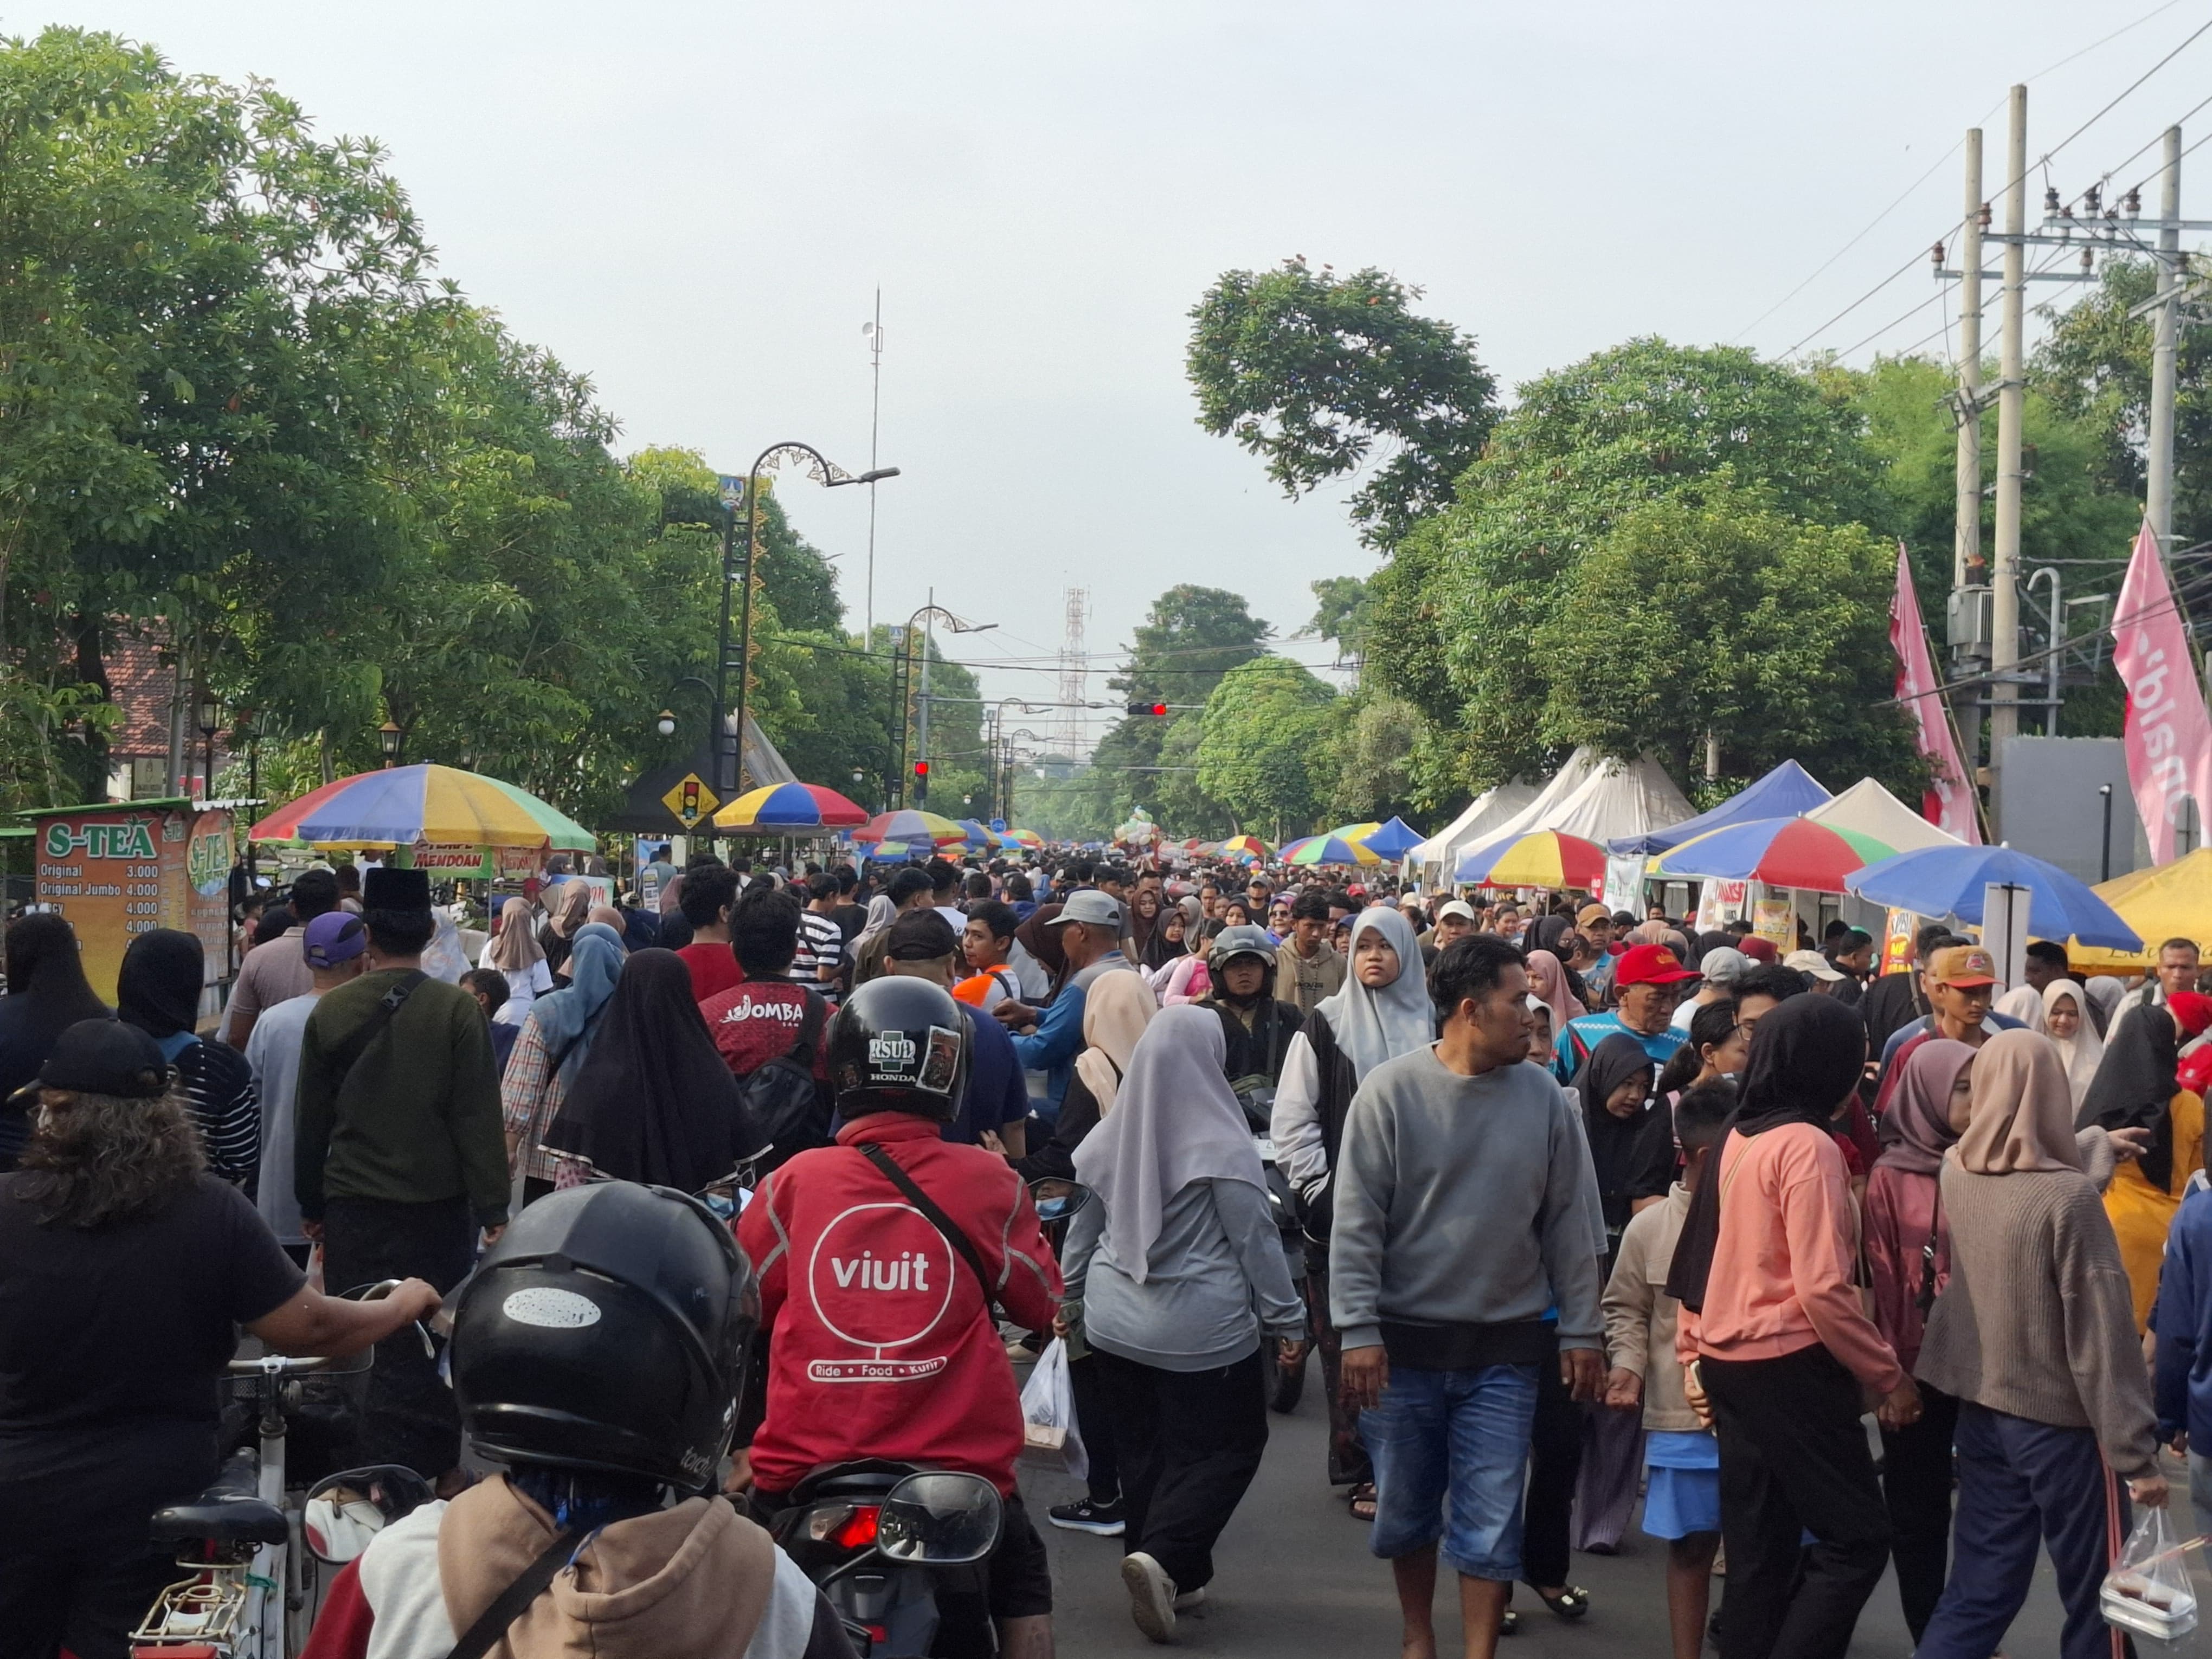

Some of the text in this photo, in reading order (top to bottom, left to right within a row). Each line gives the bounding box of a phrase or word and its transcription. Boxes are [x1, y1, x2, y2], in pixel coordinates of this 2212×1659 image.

[46, 822, 157, 858] S-TEA
[413, 853, 483, 868] MENDOAN
[41, 864, 82, 879] Original
[126, 865, 158, 878] 3.000
[41, 882, 158, 897] Original Jumbo 4.000
[126, 902, 158, 914] 4.000
[126, 920, 158, 933] 4.000
[719, 994, 803, 1024] JOMBA
[870, 1073, 916, 1082] HONDA
[831, 1250, 929, 1291] viuit
[815, 1361, 938, 1377] Ride Food Kurir
